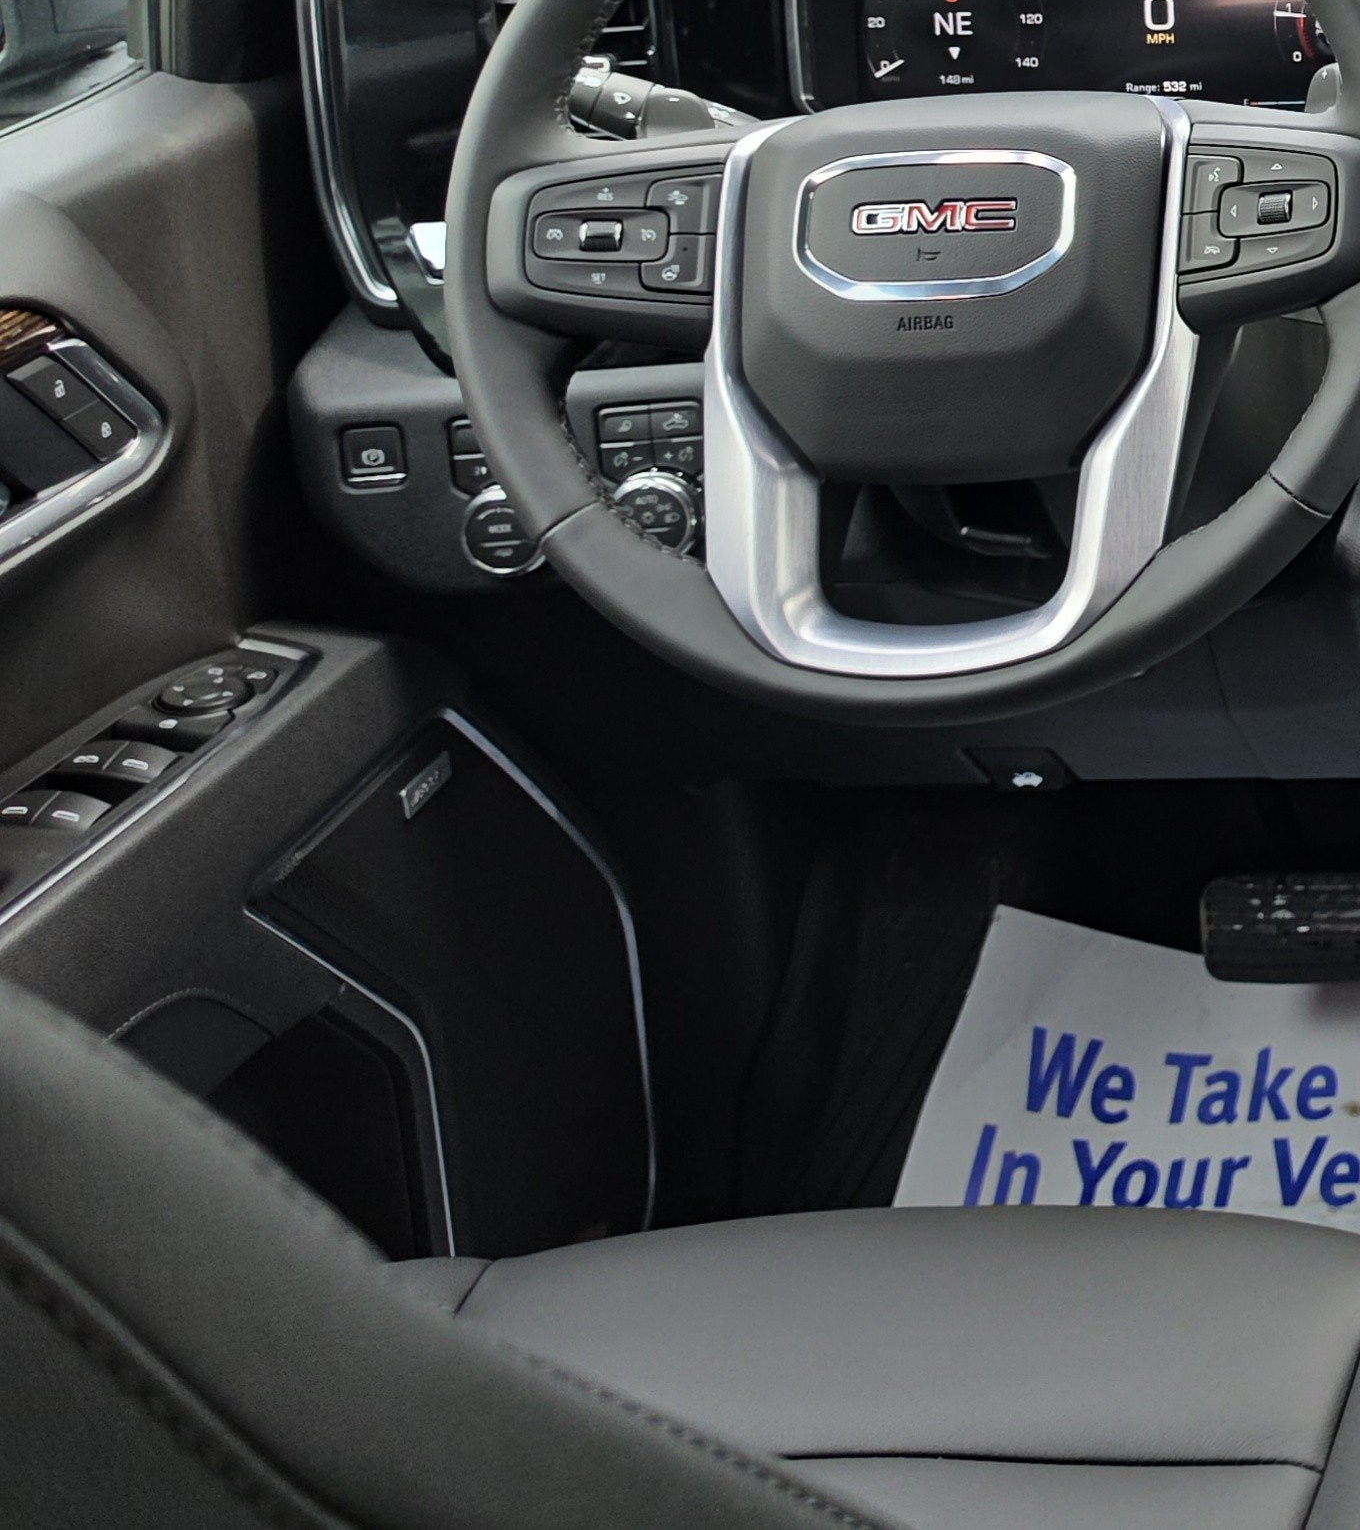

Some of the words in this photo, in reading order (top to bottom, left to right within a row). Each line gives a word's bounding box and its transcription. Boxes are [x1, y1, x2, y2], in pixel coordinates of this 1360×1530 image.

[867, 16, 886, 28] 20
[933, 11, 974, 36] NE
[1019, 13, 1043, 24] 120
[1146, 33, 1175, 45] MPH
[1015, 57, 1039, 68] 140
[1292, 51, 1302, 62] 0
[1126, 82, 1161, 95] Range:
[1162, 81, 1187, 93] 532
[1189, 81, 1203, 92] mi
[852, 199, 1017, 233] GMC
[897, 315, 955, 333] AIRBAG
[1025, 1025, 1138, 1125] We
[1164, 1046, 1337, 1126] Take
[963, 1123, 1041, 1208] In
[1072, 1138, 1252, 1211] Your
